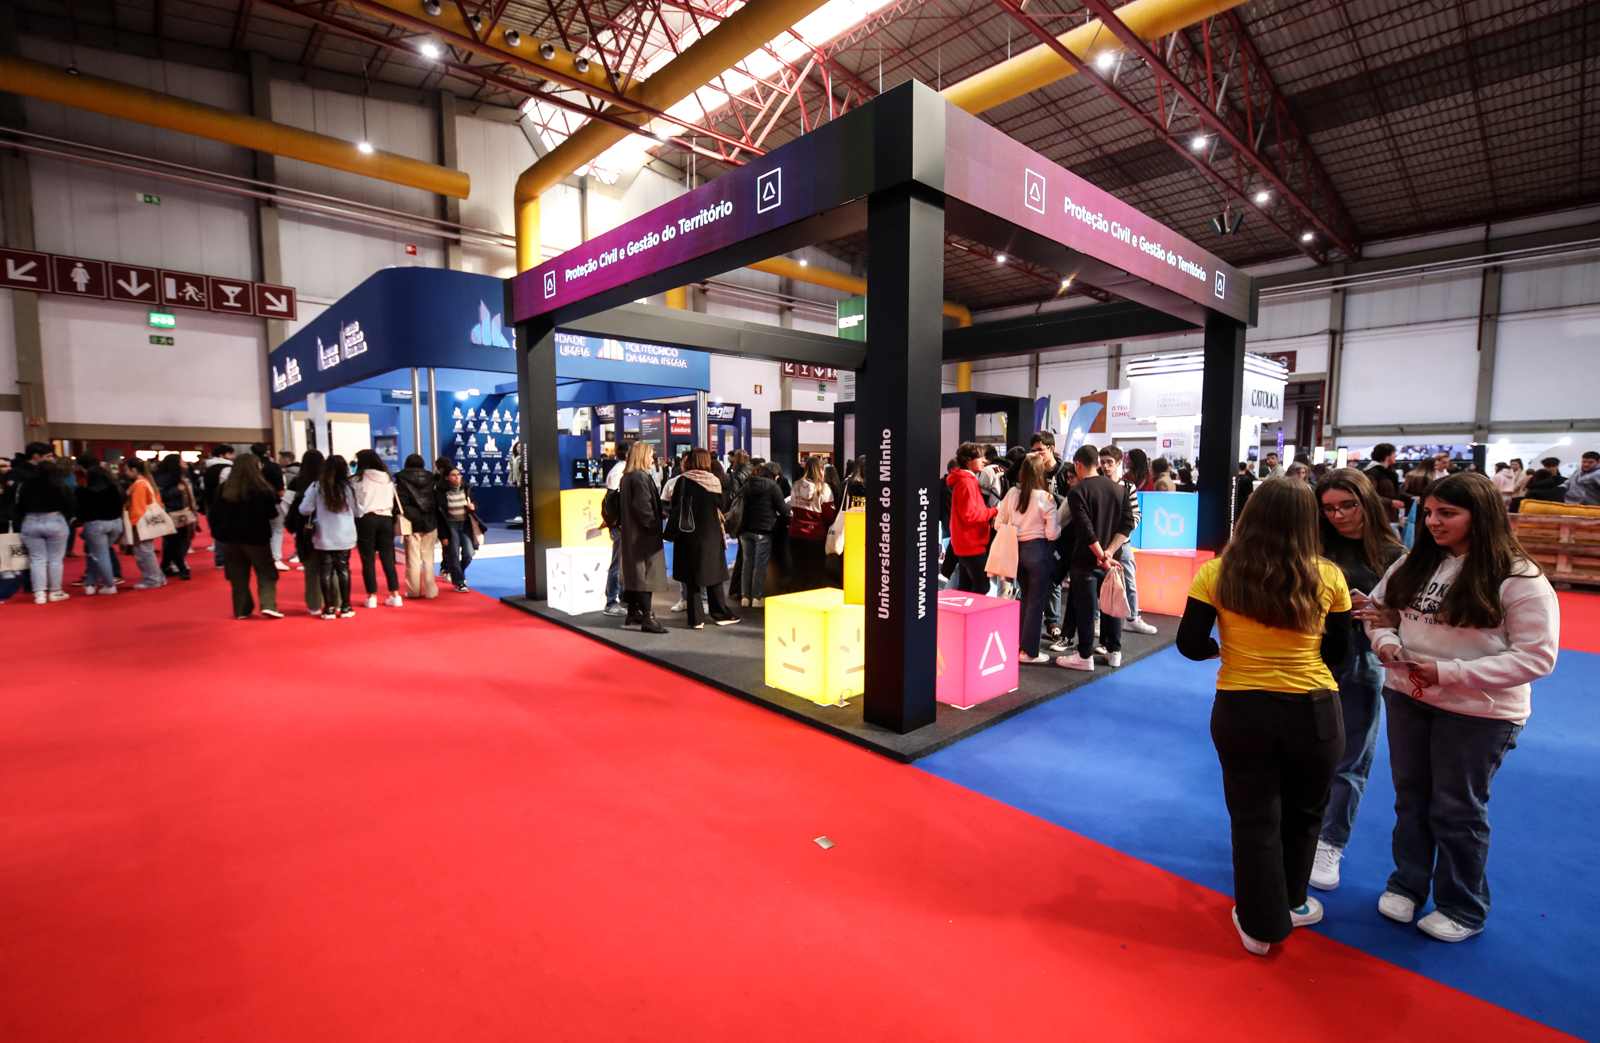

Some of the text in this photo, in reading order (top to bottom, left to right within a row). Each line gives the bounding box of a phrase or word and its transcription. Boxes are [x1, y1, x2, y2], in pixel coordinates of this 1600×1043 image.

[565, 200, 733, 282] Proteção Civil e Gestão do Território
[1064, 196, 1207, 282] Proteção Civil e Gestão do Território
[524, 473, 529, 484] do
[878, 428, 892, 620] Universidade do Minho
[917, 487, 930, 620] www.uminho.pt
[1404, 612, 1444, 626] NEW YORK
